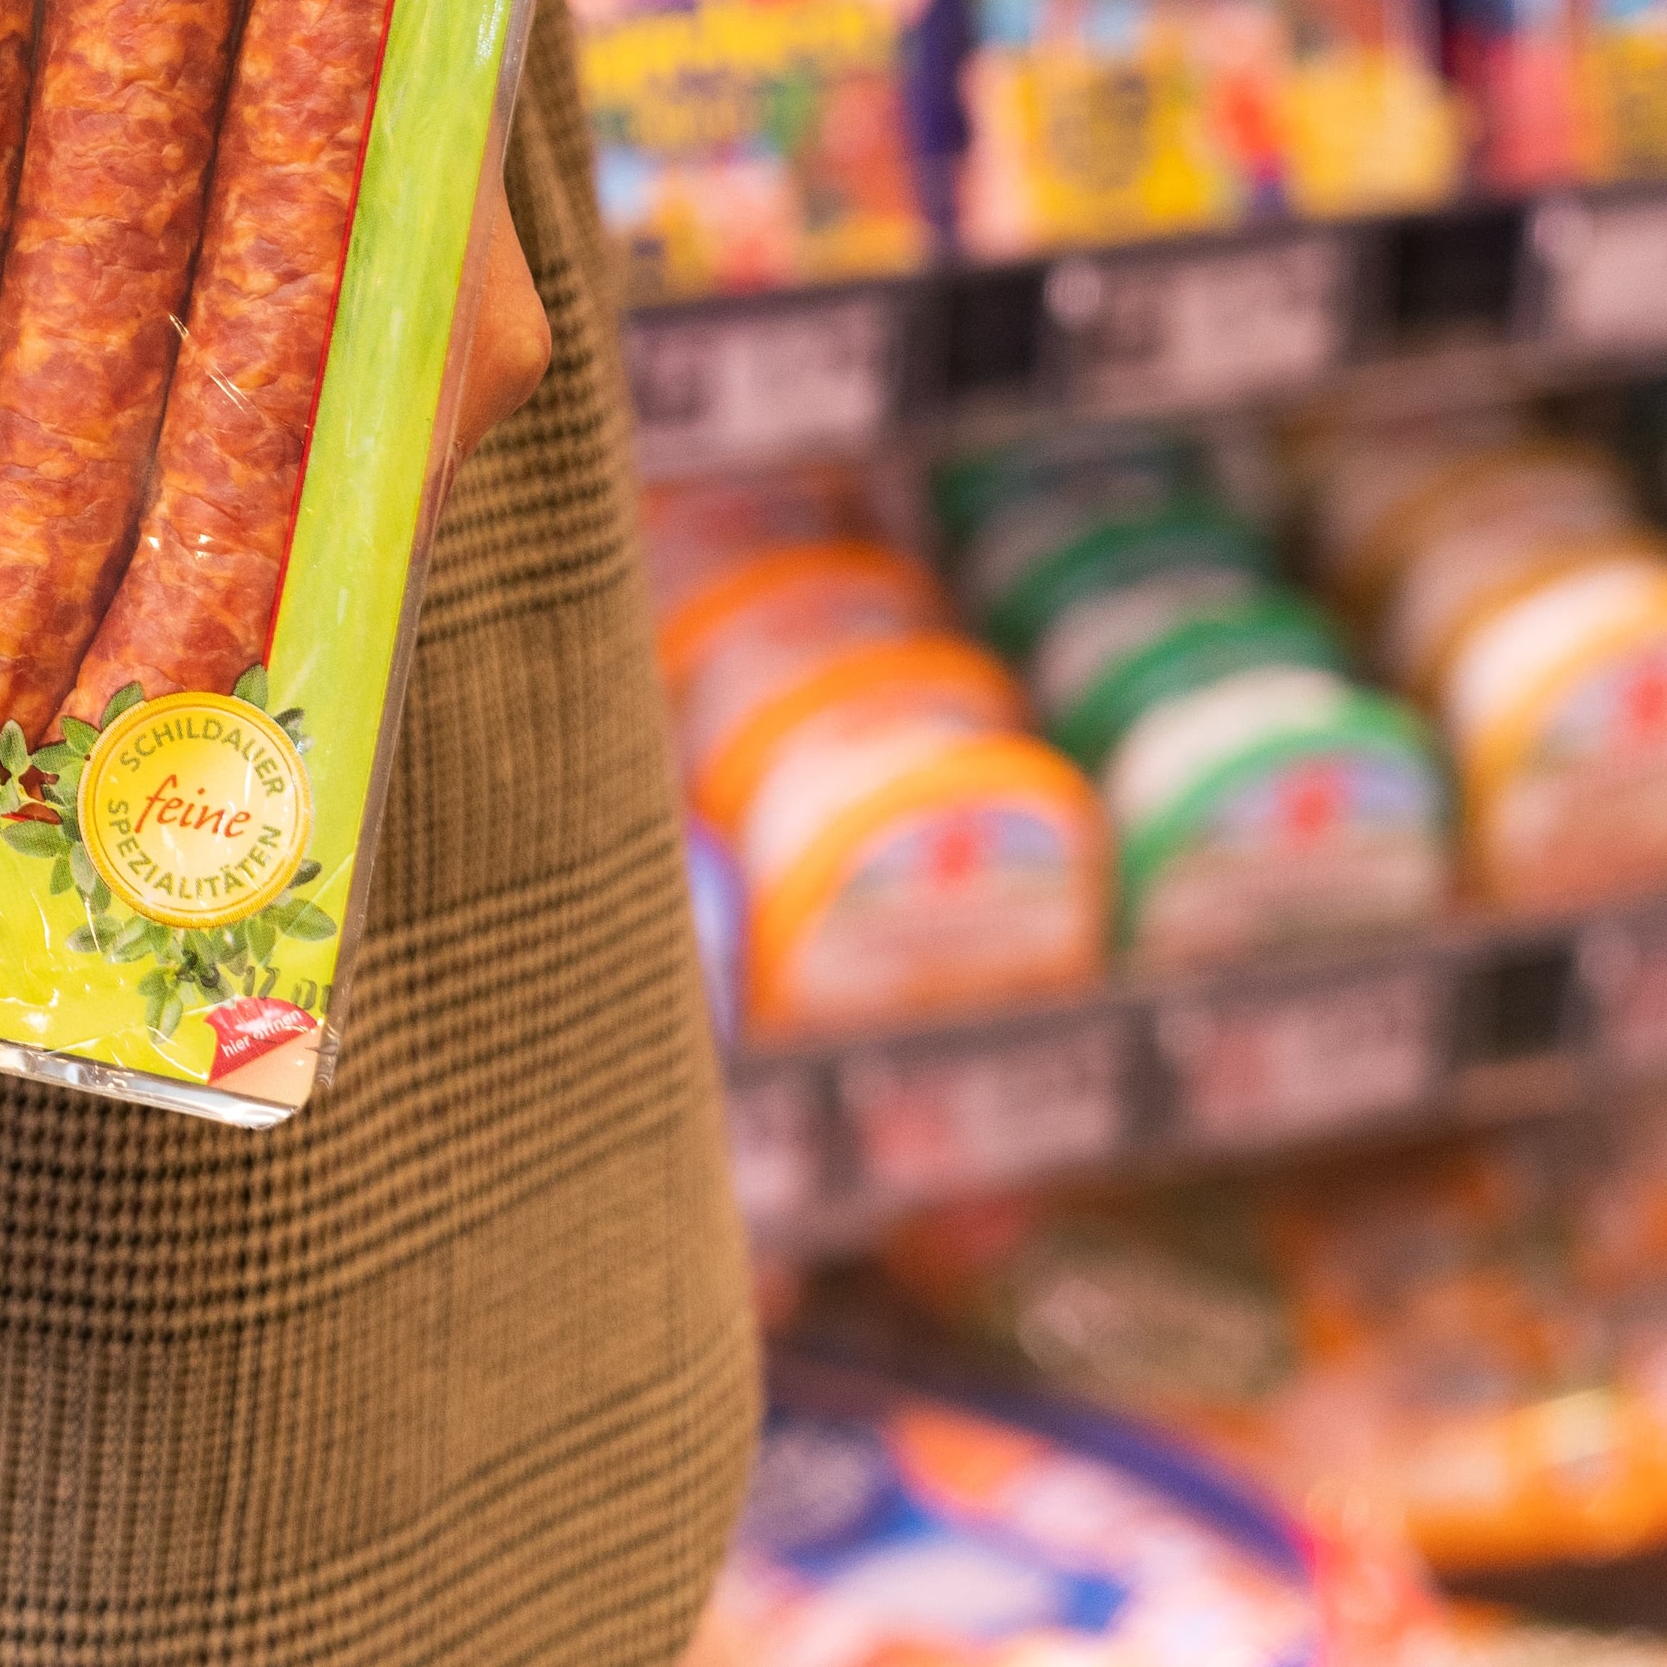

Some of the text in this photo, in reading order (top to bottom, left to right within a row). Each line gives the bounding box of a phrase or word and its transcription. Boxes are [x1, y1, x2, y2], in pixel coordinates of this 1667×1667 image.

[119, 716, 285, 797] SCHILDAUER
[134, 773, 252, 838] feine
[107, 798, 283, 901] SPEZIALITÄTEN
[221, 1035, 251, 1058] hier
